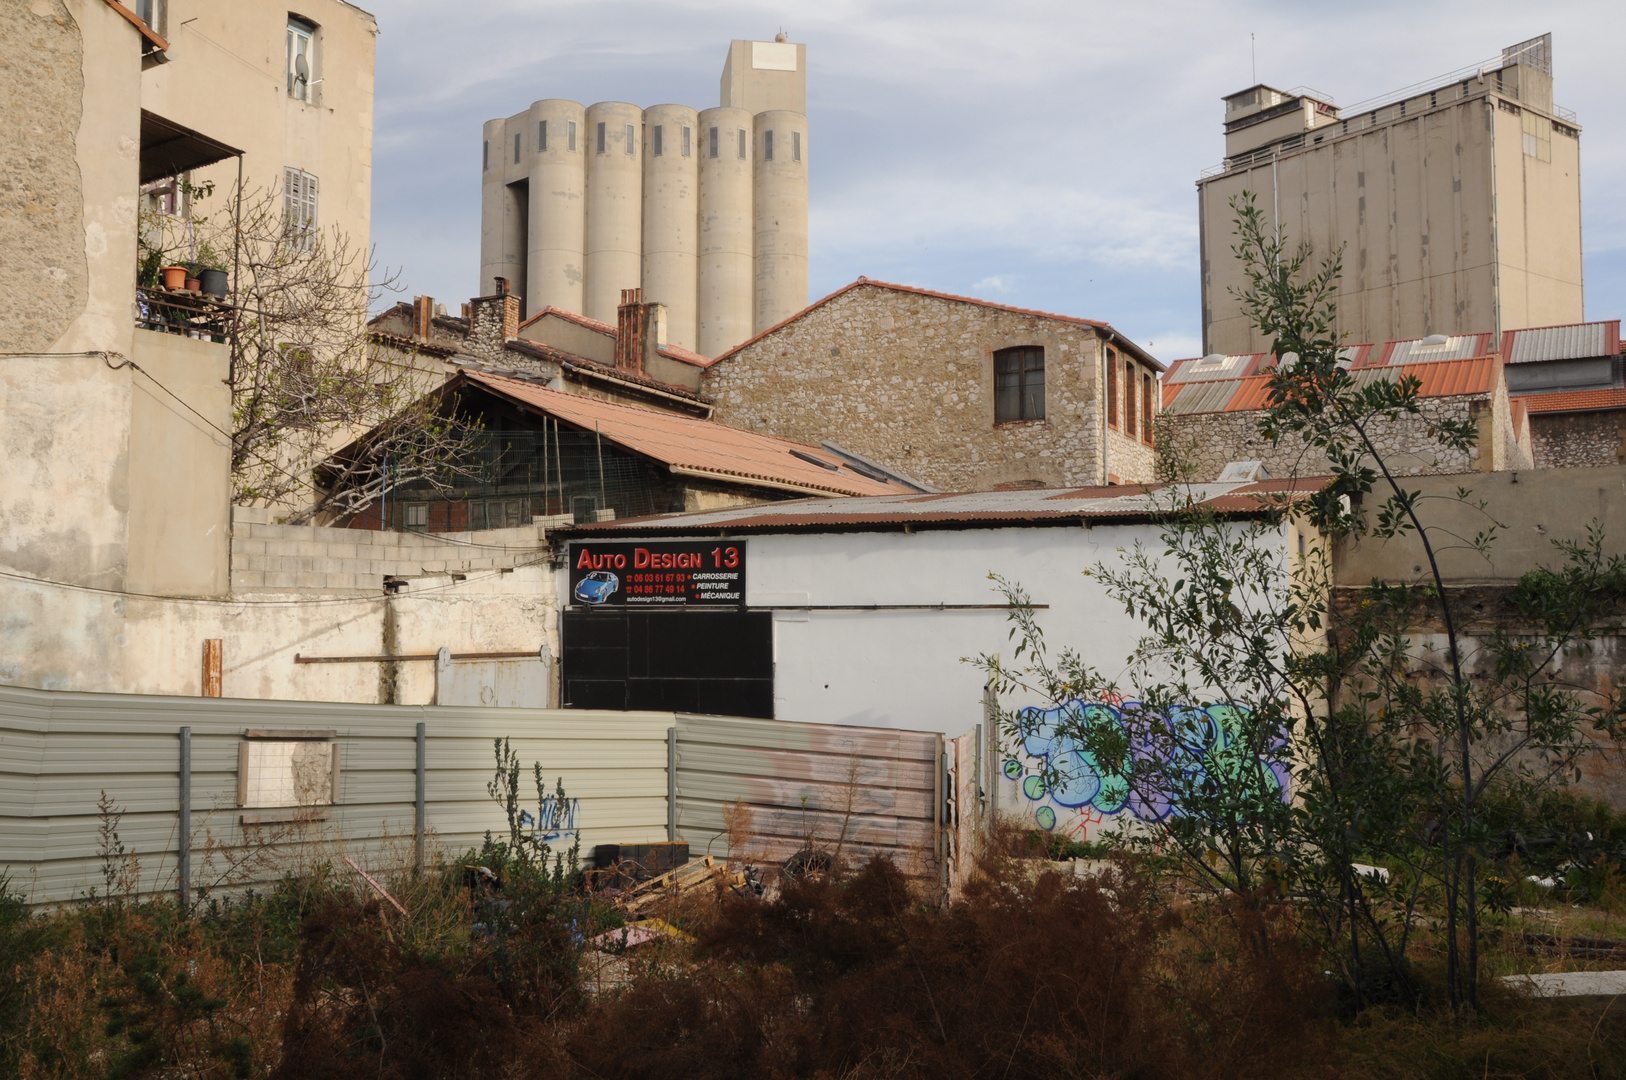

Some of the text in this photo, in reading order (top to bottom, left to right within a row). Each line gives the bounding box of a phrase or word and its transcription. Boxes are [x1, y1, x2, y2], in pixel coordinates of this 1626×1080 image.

[711, 546, 739, 568] 13
[634, 573, 685, 582] 06 03 61 67 93
[634, 585, 685, 594] 04 86 77 49 14
[700, 590, 740, 600] MÉCANIQUE
